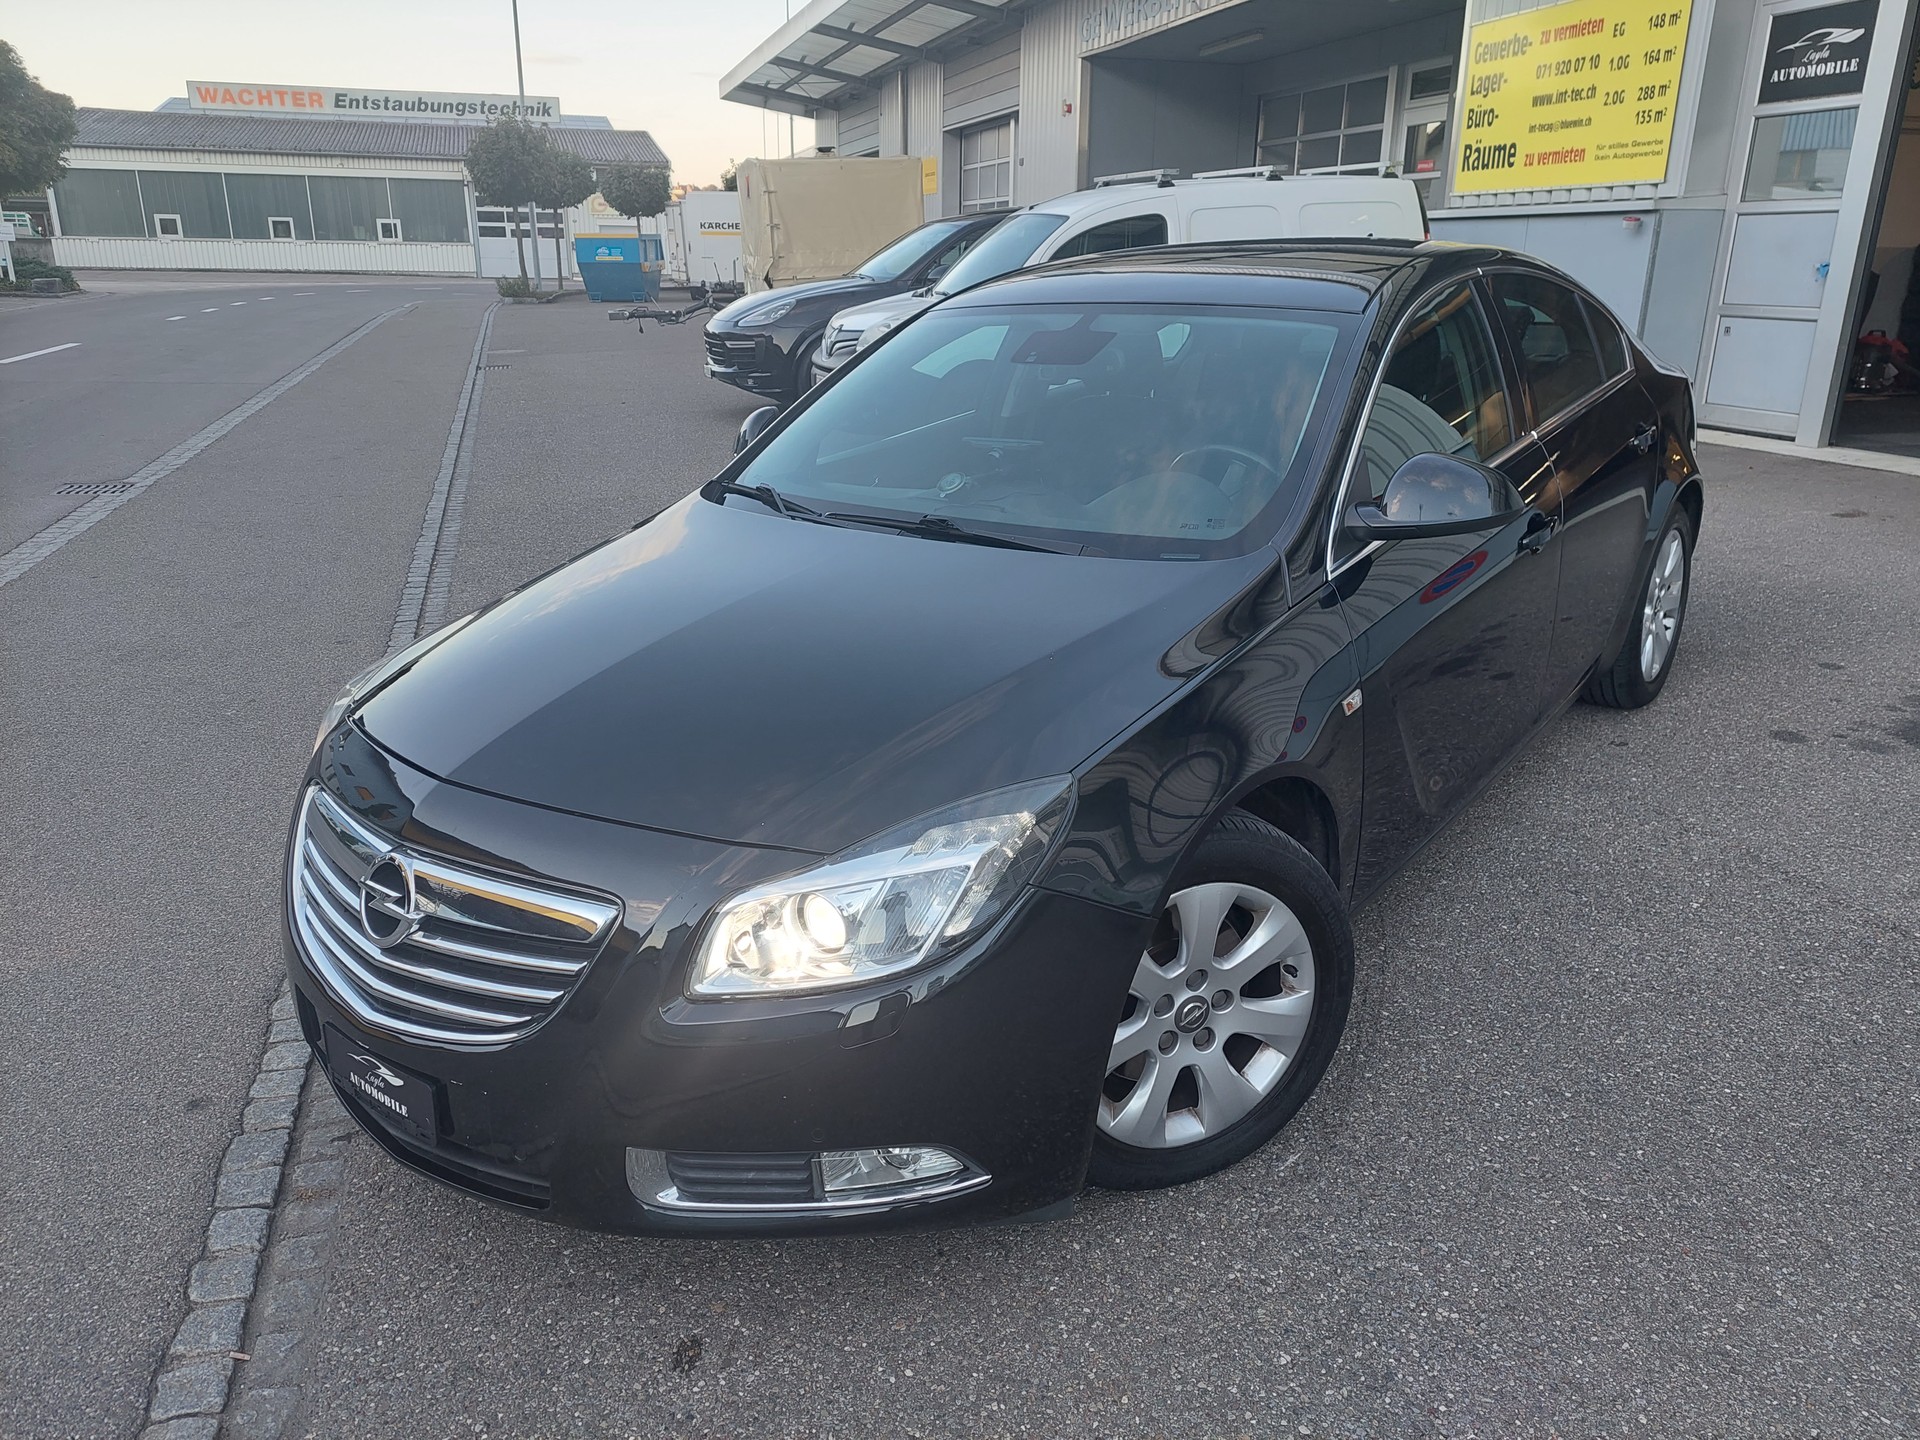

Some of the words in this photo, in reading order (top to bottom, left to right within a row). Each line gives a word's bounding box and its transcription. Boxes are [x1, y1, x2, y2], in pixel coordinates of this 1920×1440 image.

[1540, 30, 1552, 46] zu
[1554, 17, 1604, 42] vermieten
[1613, 22, 1626, 38] EG
[1648, 13, 1666, 31] 148
[1474, 33, 1533, 64] Gewerbe-
[1643, 49, 1661, 66] 164
[1536, 63, 1552, 80] 071
[1554, 59, 1572, 77] 920
[1574, 56, 1586, 73] 07
[1588, 53, 1601, 70] 10
[1770, 58, 1860, 83] AUTOMOBILE
[1470, 71, 1508, 98] Lager-
[1532, 83, 1597, 108] www.int-tec.ch
[1637, 86, 1656, 102] 288
[196, 86, 324, 109] WACHTER
[334, 92, 552, 117] Entstaubungstechnik
[1466, 105, 1499, 129] Büro-
[1635, 110, 1652, 125] 135
[1631, 138, 1664, 147] Gewerbe
[1461, 139, 1517, 172] Räume
[1524, 152, 1535, 167] zu
[1537, 147, 1586, 165] vermieten
[350, 1072, 408, 1117] AUTOMOBILE
